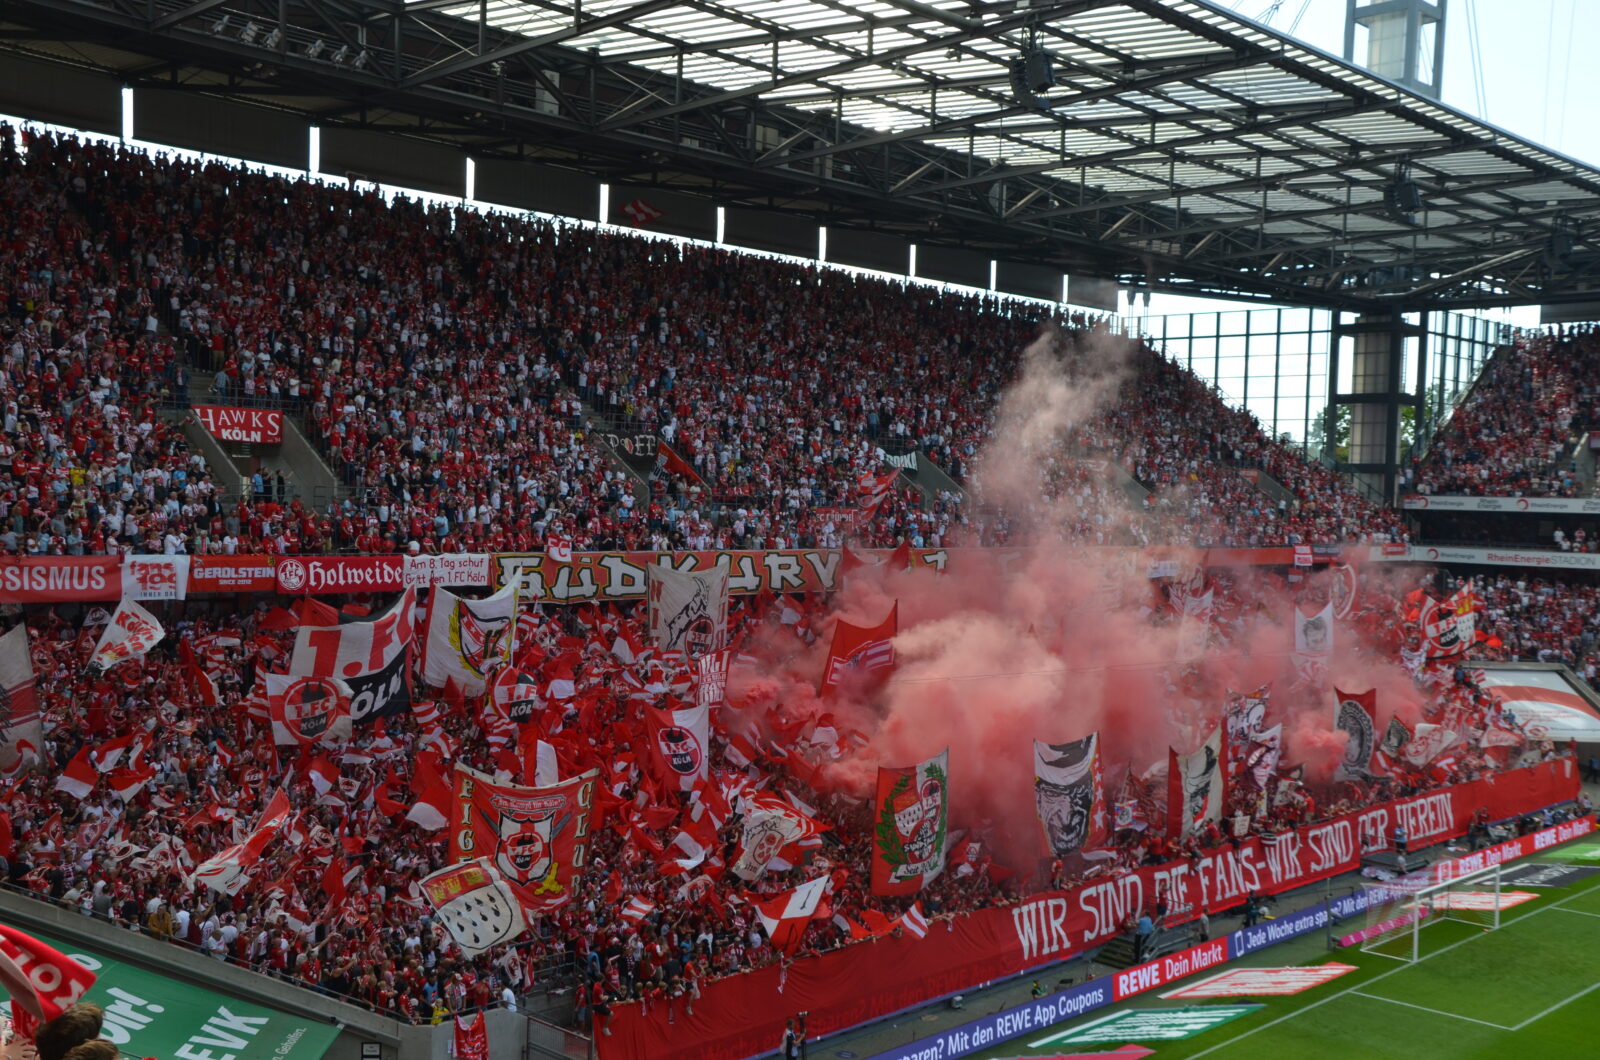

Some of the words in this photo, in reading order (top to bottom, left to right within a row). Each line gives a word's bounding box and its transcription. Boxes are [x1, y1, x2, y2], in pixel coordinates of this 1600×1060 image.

[195, 408, 280, 436] HAWKS
[221, 427, 262, 442] KÖLN
[193, 567, 276, 579] GEROLSTEIN
[410, 559, 426, 570] Am
[429, 558, 438, 570] 8.
[440, 558, 456, 571] Tag
[458, 557, 484, 569] schuf
[1487, 553, 1596, 566] RheinEnergieSTADION
[0, 565, 105, 592] SISMUS
[308, 561, 403, 590] Holweide
[455, 572, 465, 583] FC
[467, 571, 486, 583] Köln
[350, 663, 404, 721] ÖLN
[296, 700, 334, 718] 1.FC
[301, 716, 327, 731] KÖLN
[1534, 828, 1557, 850] REWE
[1572, 818, 1591, 838] Markt
[1458, 852, 1484, 876] REWE
[1502, 841, 1523, 860] Markt
[1012, 898, 1071, 960] WIR
[1080, 874, 1143, 942] SIND
[1154, 863, 1189, 915] DIE
[1308, 820, 1354, 872] SIND
[1358, 808, 1389, 855] DER
[1395, 792, 1454, 841] VEREIN
[1246, 929, 1267, 950] Jede
[1267, 922, 1294, 942] Woche
[1295, 916, 1314, 933] extra
[1342, 898, 1356, 915] Mit
[1356, 894, 1368, 911] den
[1119, 963, 1161, 997] REWE
[1165, 955, 1190, 980] Dein
[1191, 943, 1223, 969] Markt
[897, 1038, 944, 1060] aren?
[948, 1029, 969, 1056] Mit
[972, 1026, 994, 1048] den
[996, 1007, 1032, 1038] REWE
[1034, 1003, 1057, 1027] App
[1059, 987, 1104, 1016] Coupons
